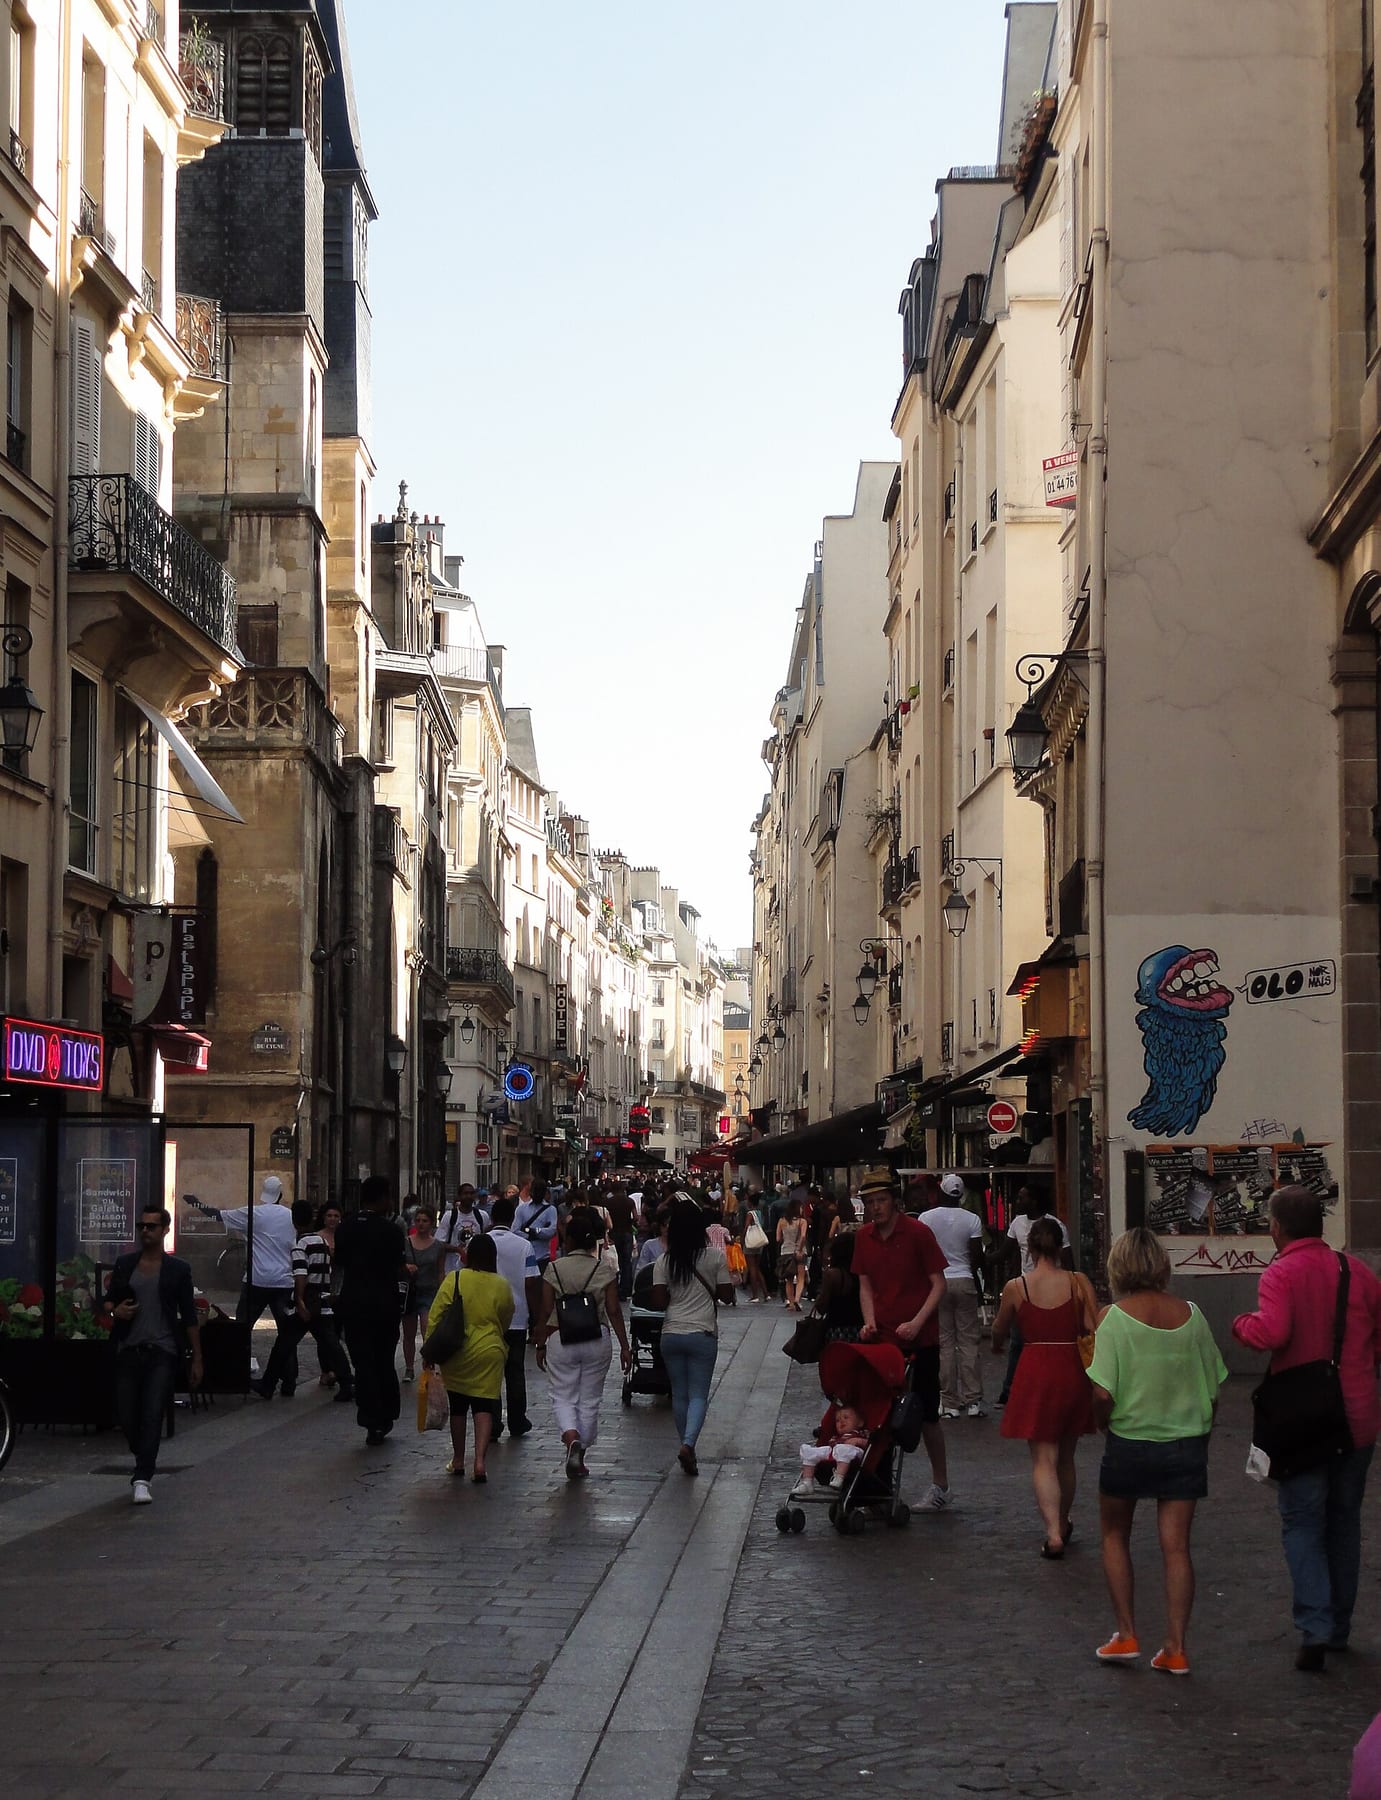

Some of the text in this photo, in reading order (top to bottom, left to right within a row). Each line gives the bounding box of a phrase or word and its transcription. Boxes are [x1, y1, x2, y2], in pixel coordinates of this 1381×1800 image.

[1045, 460, 1052, 469] A
[1047, 481, 1055, 493] 01
[1057, 479, 1065, 491] 44
[1066, 476, 1075, 488] 76
[1250, 969, 1304, 999] OLO
[556, 986, 566, 1041] HOTEL
[10, 1030, 100, 1081] DVD TOYS
[85, 1188, 131, 1197] Sandwich
[89, 1220, 126, 1229] Dessert
